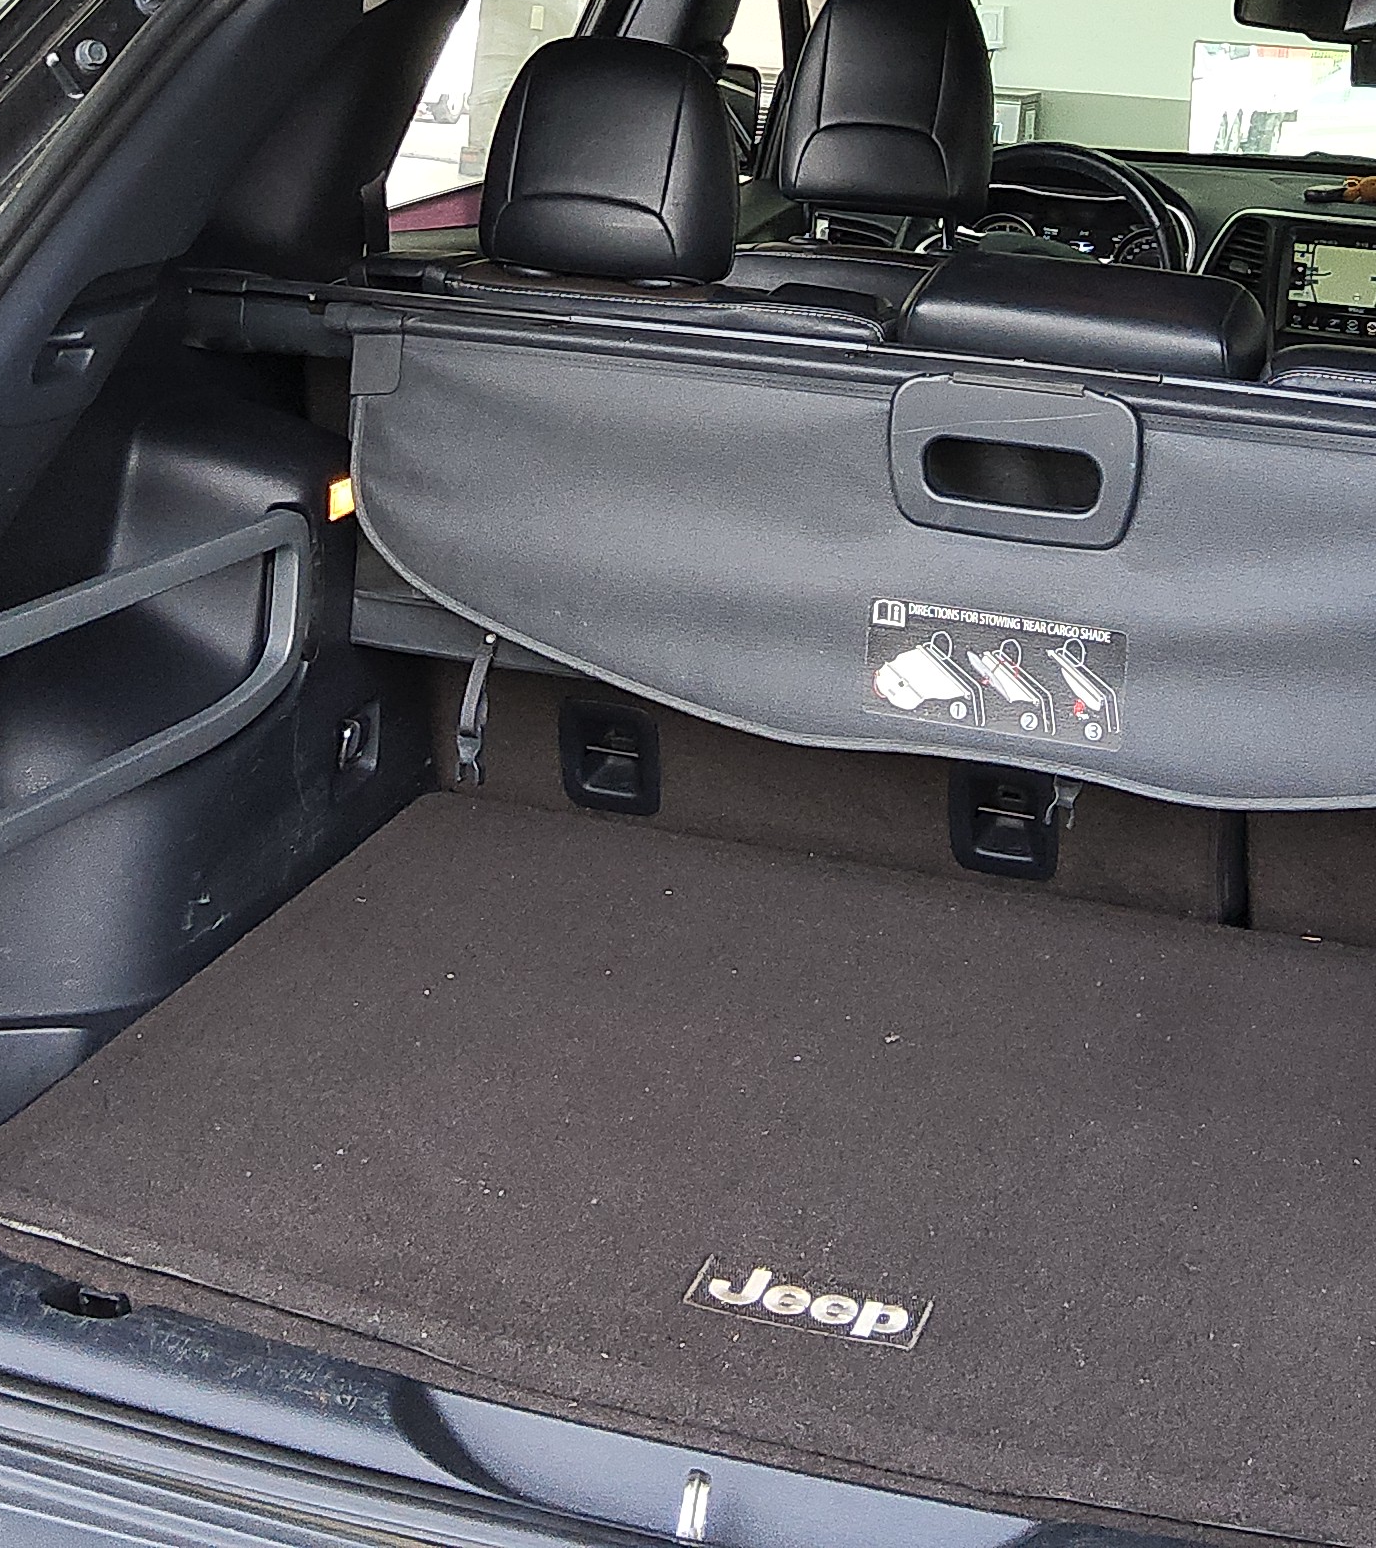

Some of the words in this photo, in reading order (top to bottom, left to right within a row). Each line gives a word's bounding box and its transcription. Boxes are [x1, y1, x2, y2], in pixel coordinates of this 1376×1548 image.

[908, 602, 960, 621] DIRECTIONS
[960, 610, 979, 624] FOR
[979, 613, 1021, 630] STOWING
[1047, 623, 1080, 638] CARGO
[1080, 628, 1112, 644] SHADE
[708, 1266, 910, 1338] Jeep
